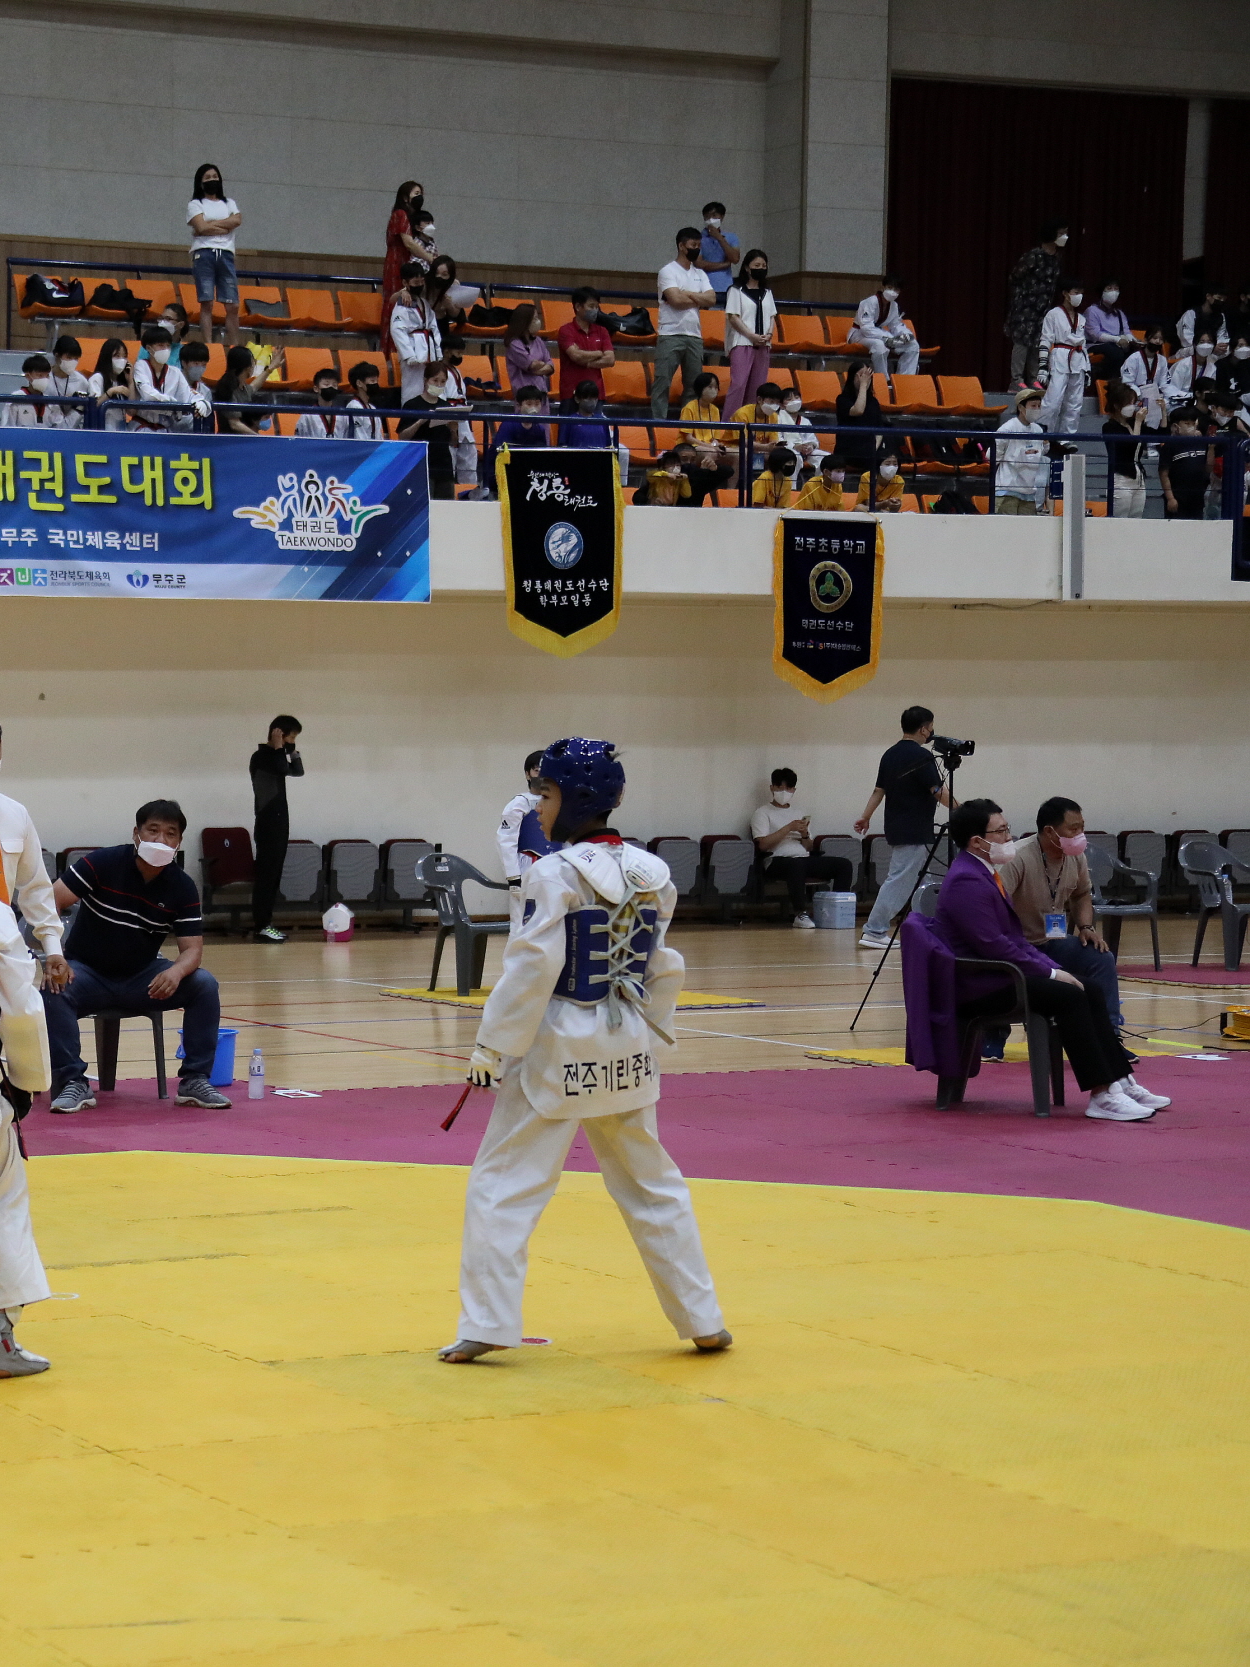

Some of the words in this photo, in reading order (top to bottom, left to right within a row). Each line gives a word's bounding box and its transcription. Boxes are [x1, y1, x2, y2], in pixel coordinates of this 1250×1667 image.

[295, 520, 336, 534] 태권도
[0, 528, 39, 547] 무주
[47, 529, 160, 551] 국민체육센터
[278, 534, 354, 548] TAEKWONDO
[794, 536, 866, 554] 전주초등학교
[49, 570, 111, 581] 전라북도체육회
[152, 574, 186, 584] 무주군
[802, 619, 854, 632] 태권도선수단
[563, 1051, 655, 1096] 전주기린중학
